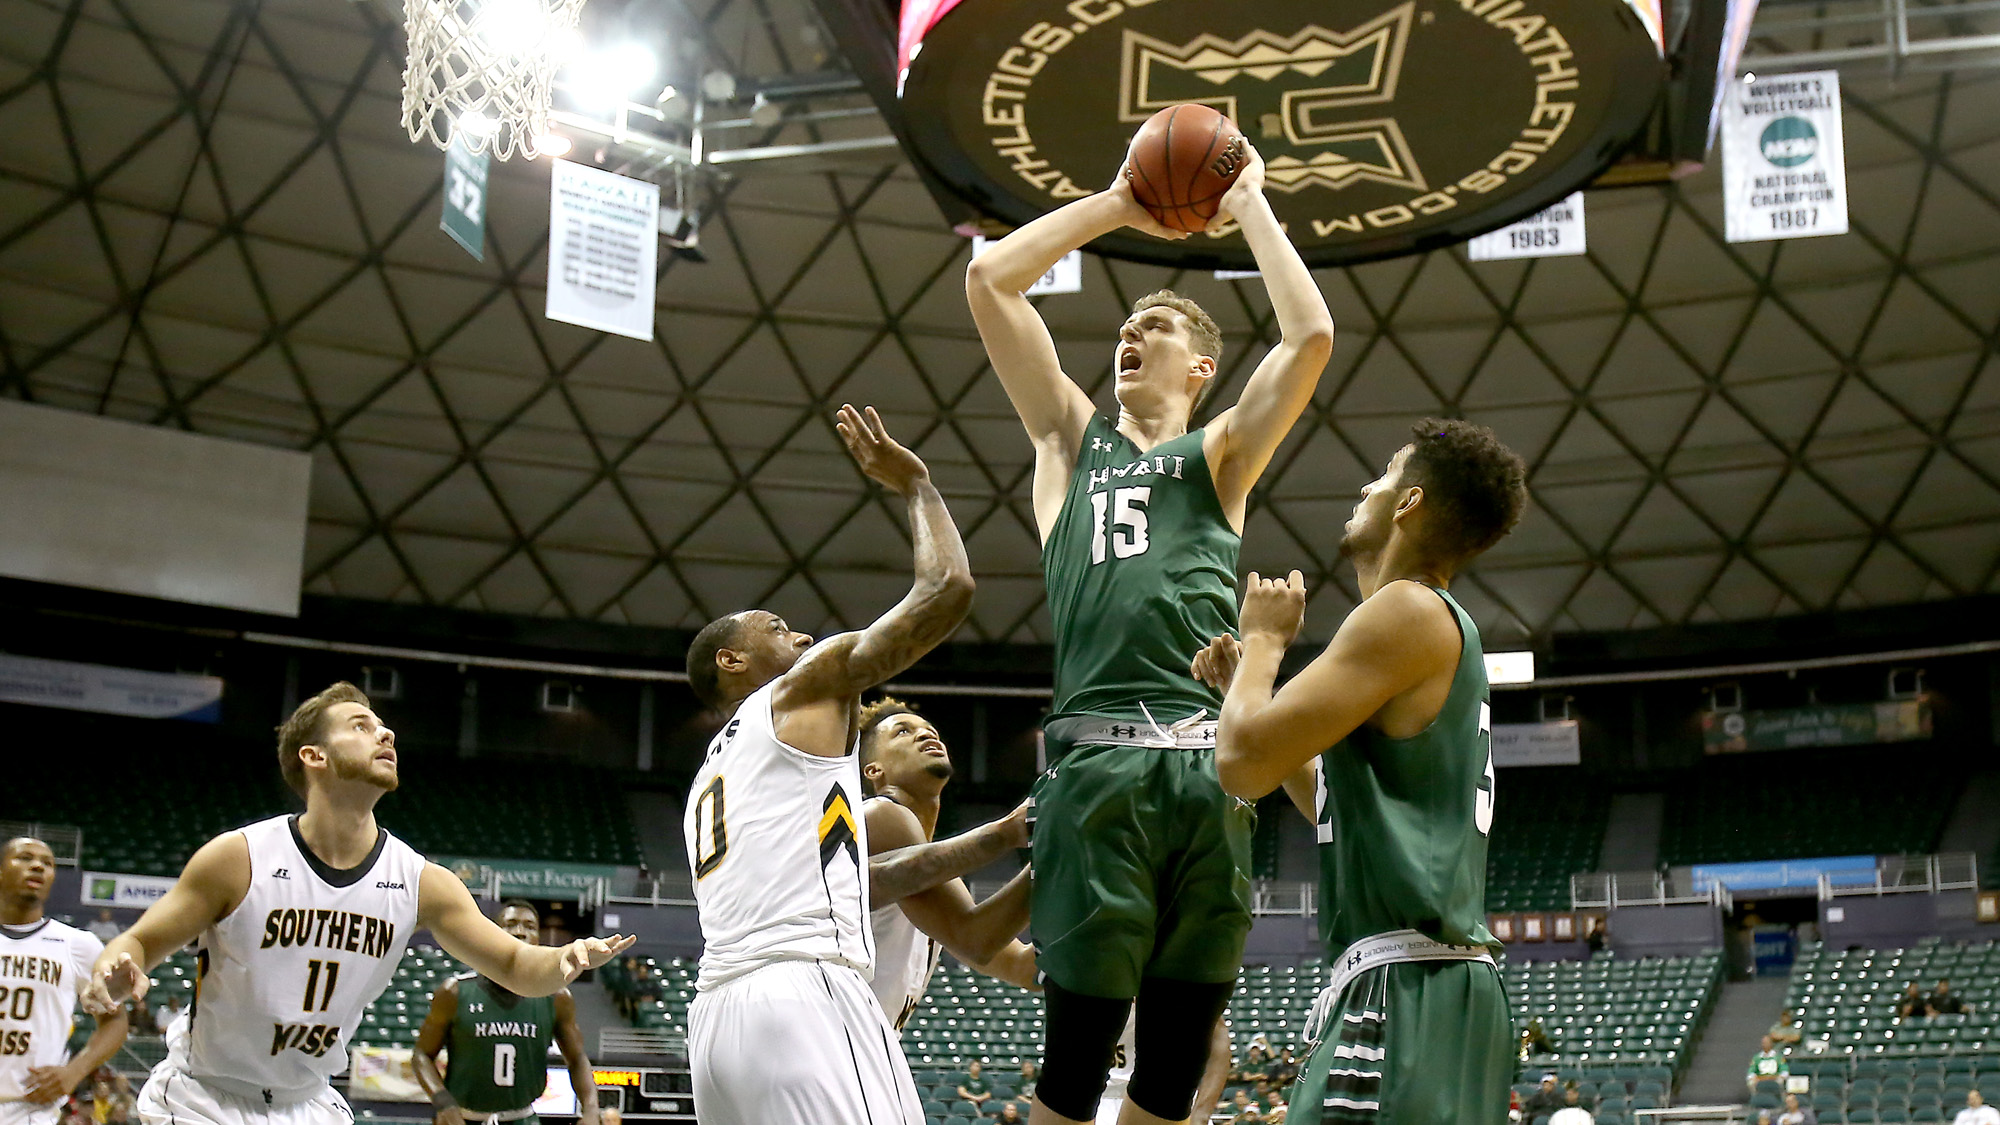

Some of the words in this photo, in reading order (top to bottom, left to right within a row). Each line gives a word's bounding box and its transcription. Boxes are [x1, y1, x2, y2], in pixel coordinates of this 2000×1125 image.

[1751, 80, 1823, 97] WOMEN'S
[1743, 97, 1832, 115] VOLLEYBALL
[1755, 171, 1827, 189] NATIONAL
[1751, 189, 1835, 207] CHAMPION
[1769, 208, 1819, 230] 1987
[1510, 227, 1559, 249] 1983
[1090, 485, 1152, 566] 15
[693, 773, 728, 881] 0
[259, 907, 395, 960] SOUTHERN
[1364, 943, 1404, 958] ARMOUR
[302, 959, 341, 1013] 11
[269, 1022, 341, 1059] MISS
[493, 1043, 517, 1087] 0
